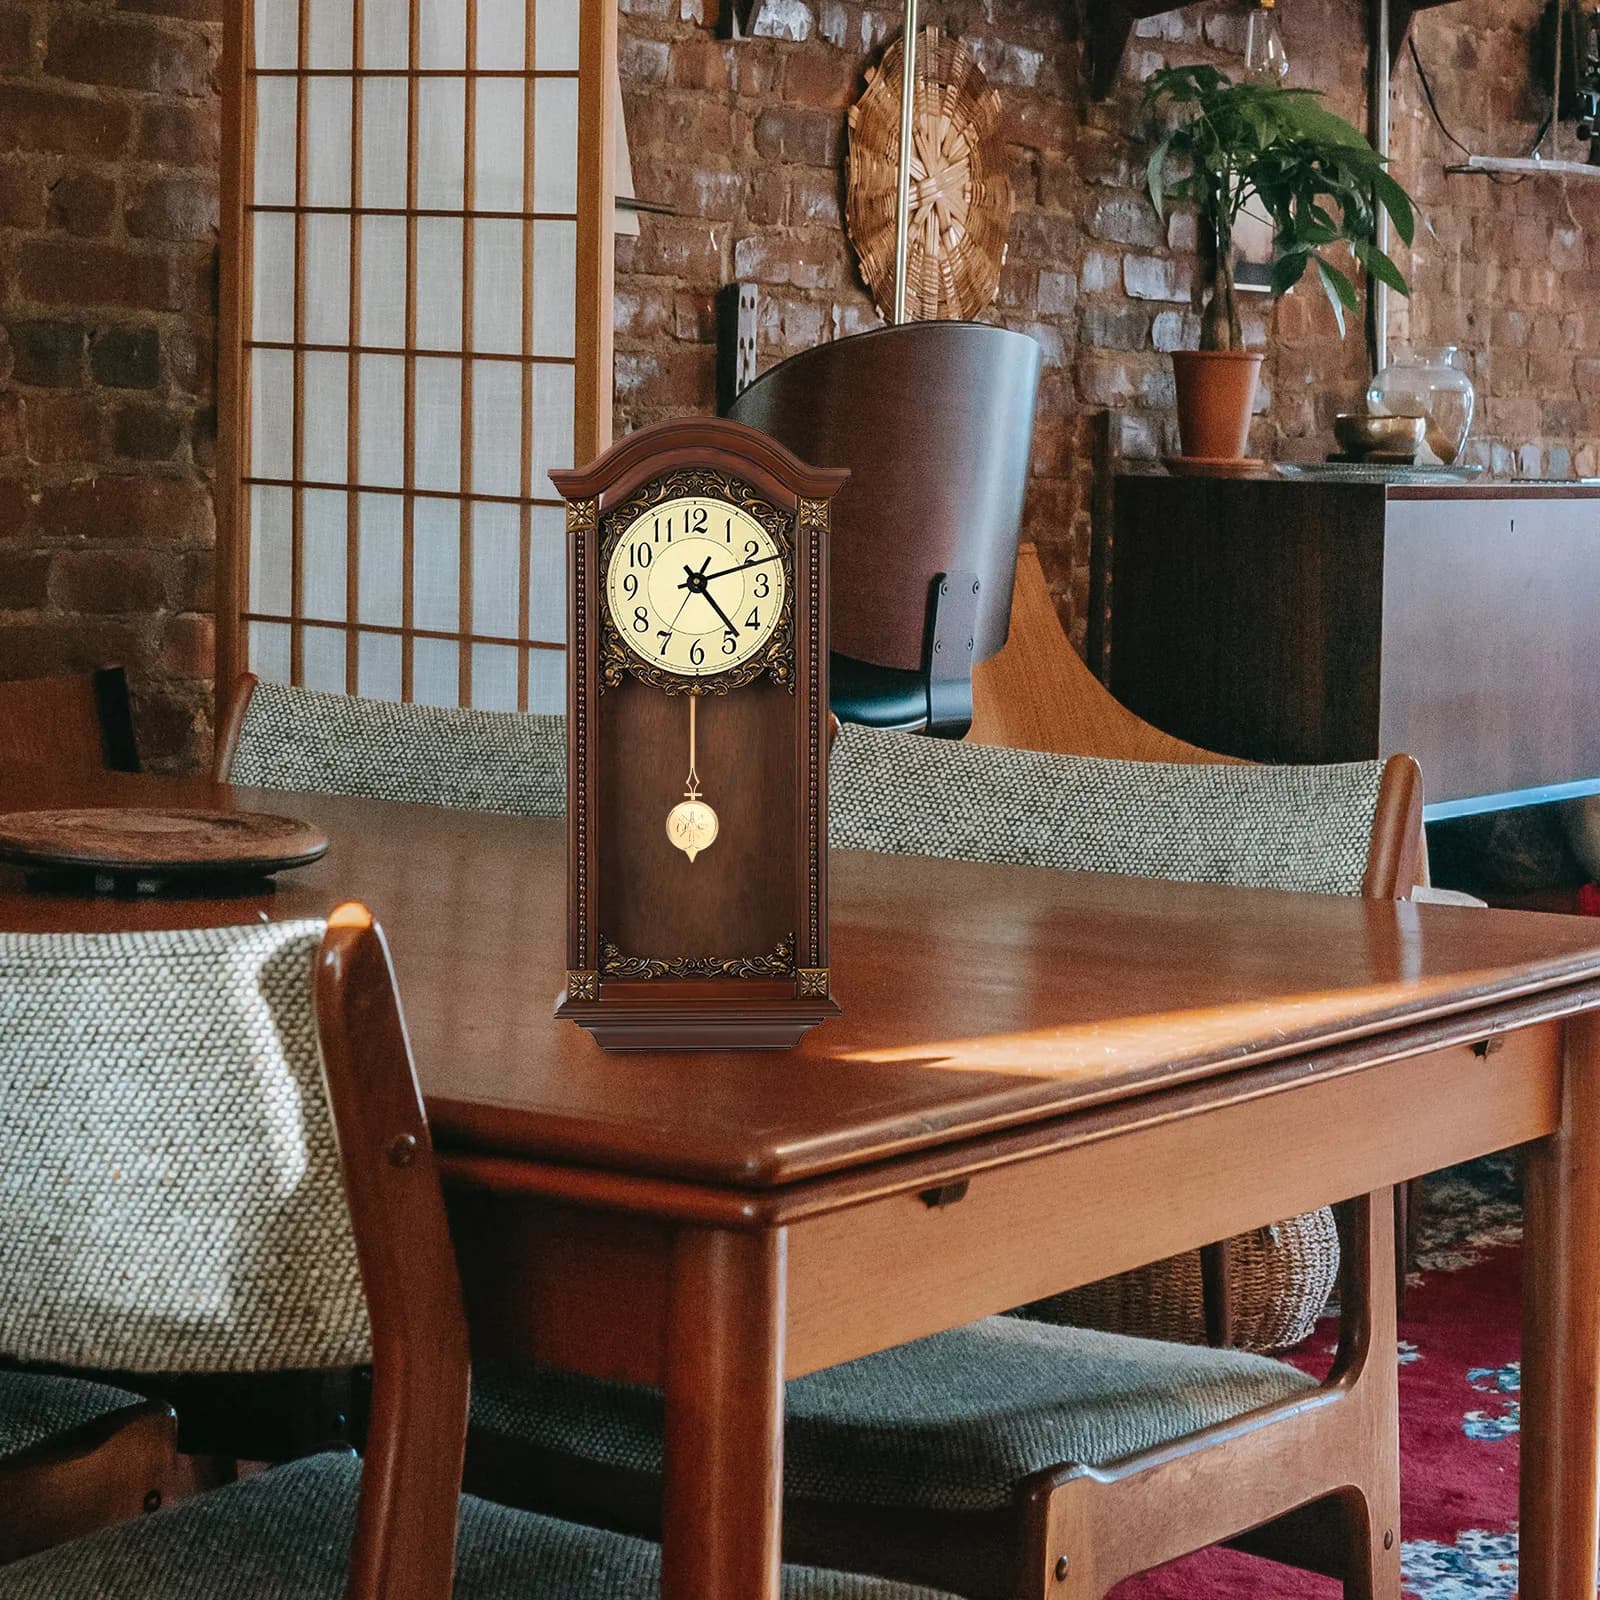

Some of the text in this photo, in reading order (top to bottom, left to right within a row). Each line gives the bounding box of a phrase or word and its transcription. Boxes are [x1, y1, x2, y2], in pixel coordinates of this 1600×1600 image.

[654, 518, 671, 542] 11
[685, 508, 708, 533] 12
[725, 518, 731, 543] 1
[630, 542, 652, 568] 10
[744, 541, 759, 566] 2
[624, 574, 638, 601] 9
[754, 573, 769, 598] 3
[633, 606, 648, 632] 8
[745, 606, 760, 630] 4
[657, 630, 672, 655] 7
[690, 639, 704, 665] 6
[722, 630, 737, 654] 5
